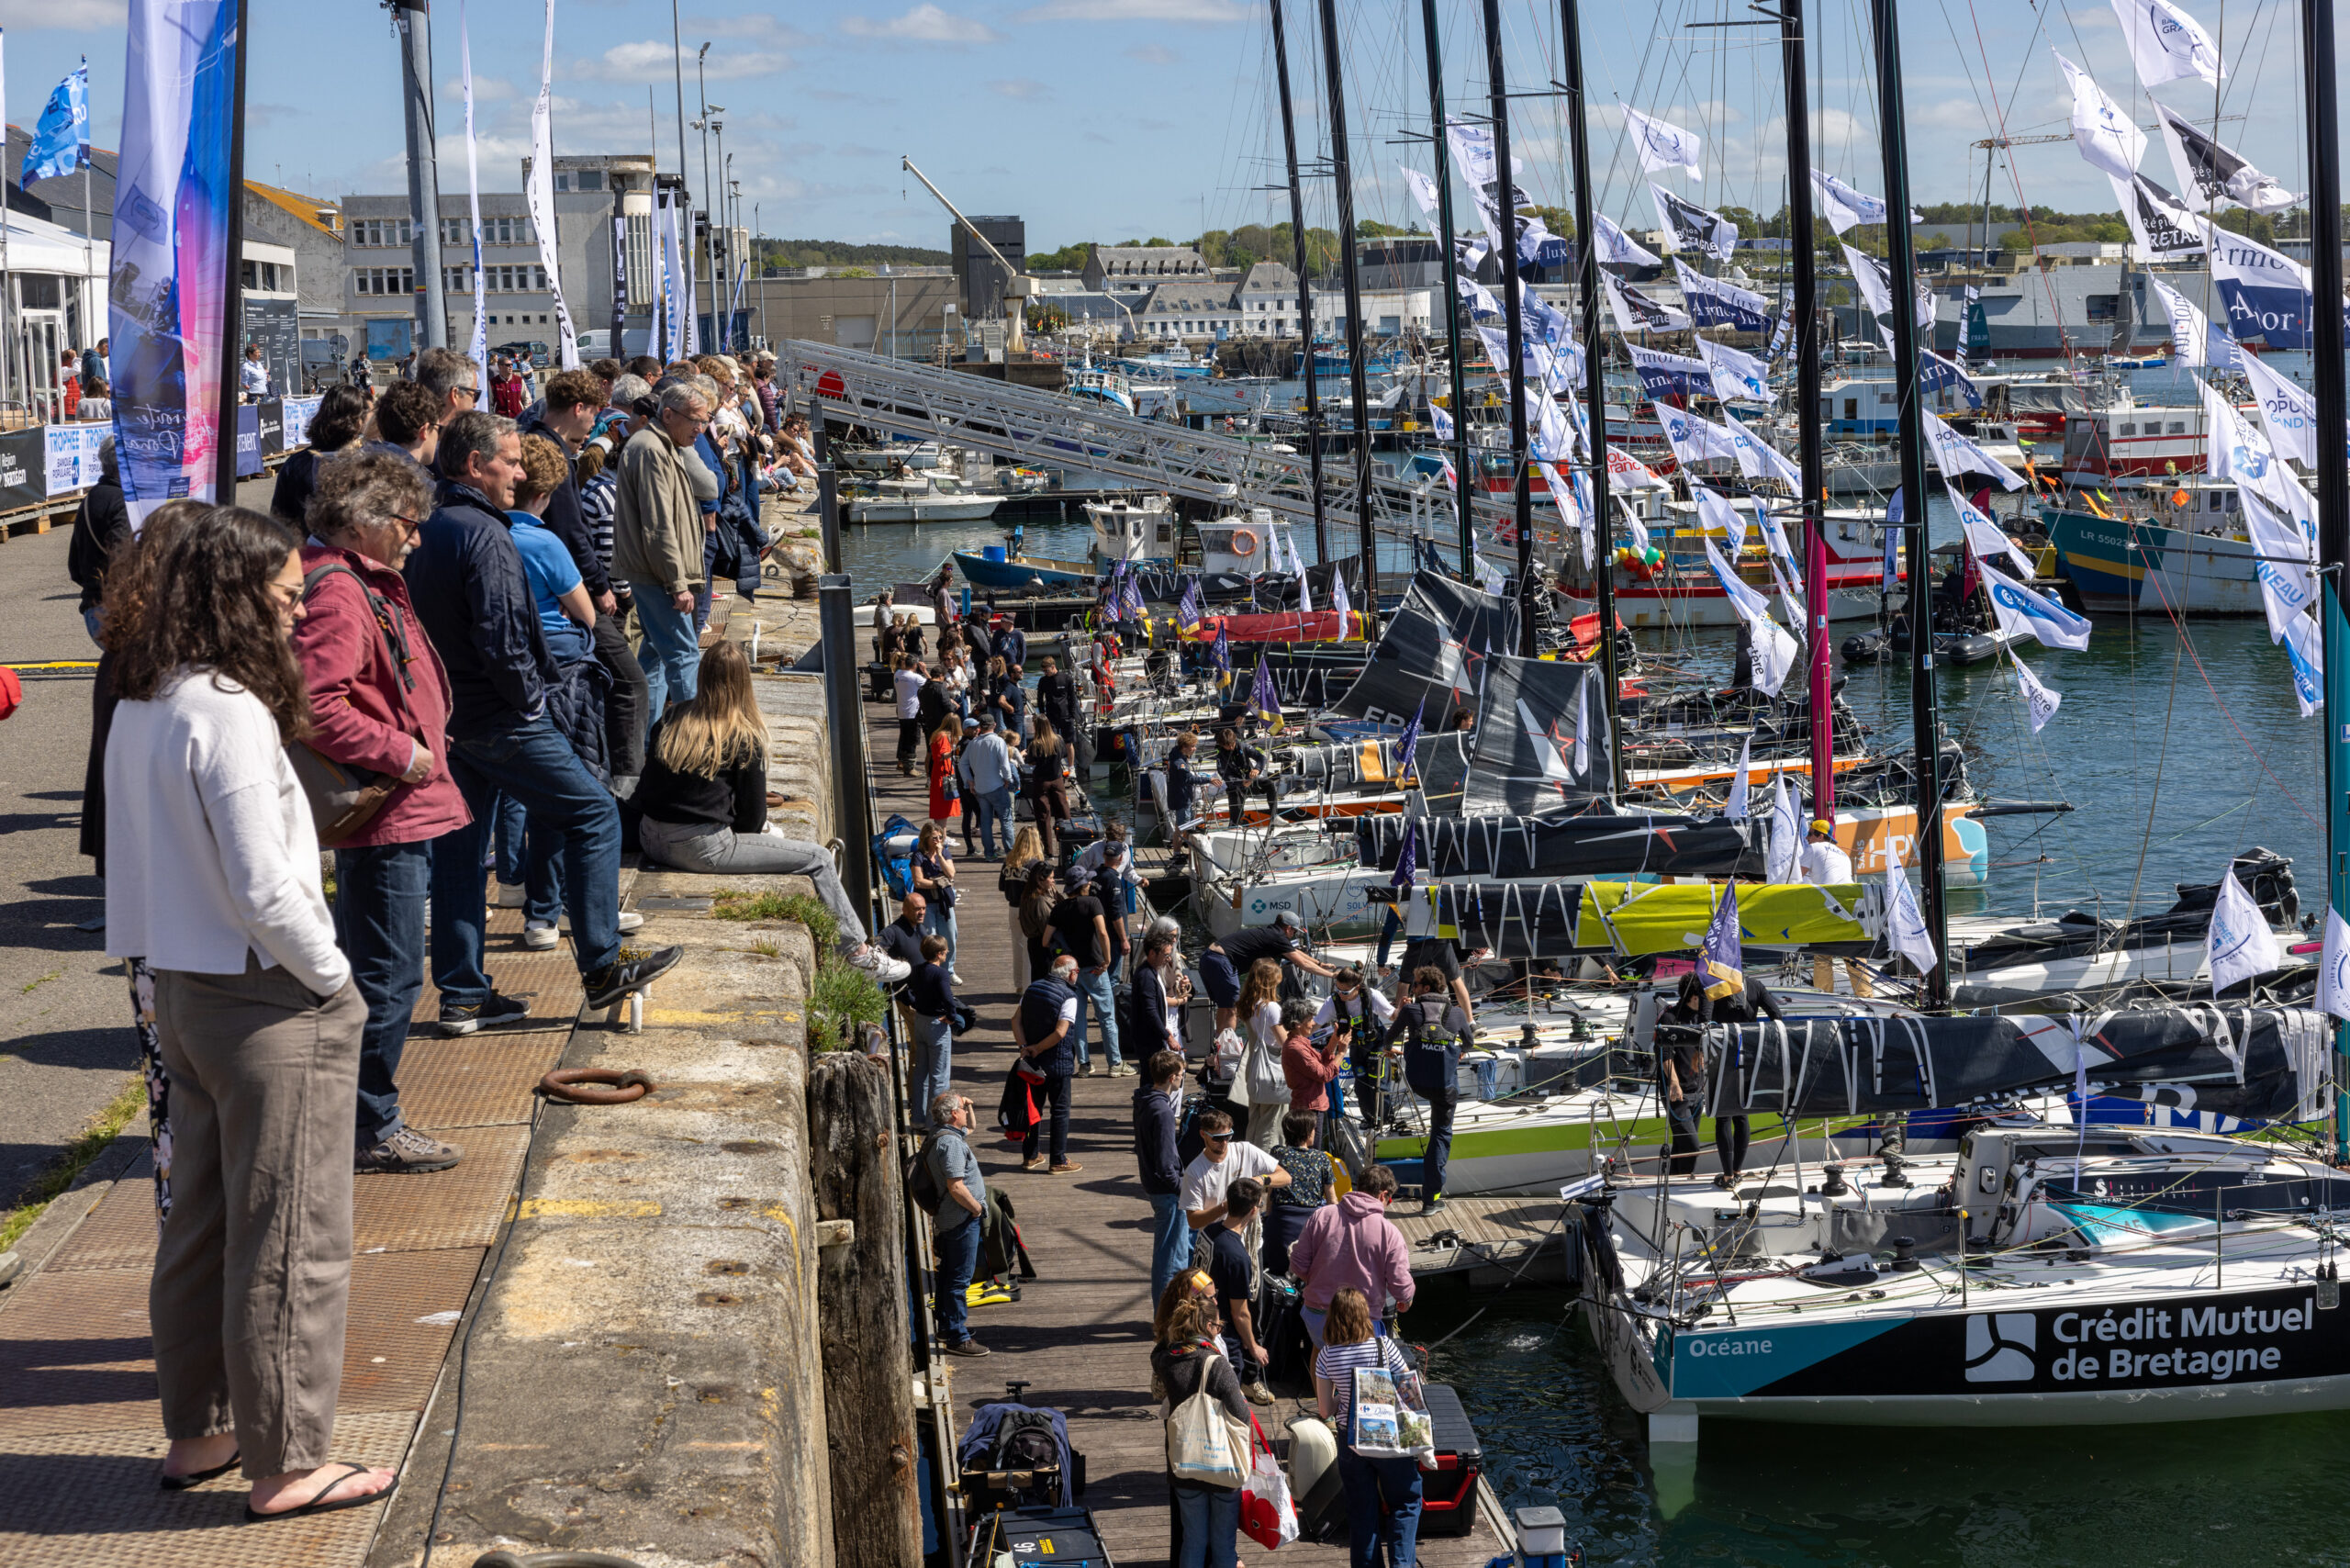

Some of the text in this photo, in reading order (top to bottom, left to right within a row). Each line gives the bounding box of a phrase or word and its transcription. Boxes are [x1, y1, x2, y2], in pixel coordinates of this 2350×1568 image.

[1636, 352, 1673, 364] rmor
[49, 431, 80, 453] TROPHEE
[1270, 902, 1292, 910] MSD
[1421, 1043, 1447, 1052] MACIF
[2053, 1297, 2314, 1343] Crédit Mutuel
[1689, 1338, 1773, 1358] Océane
[2051, 1346, 2281, 1381] de Bretagne
[1013, 1541, 1037, 1553] 46
